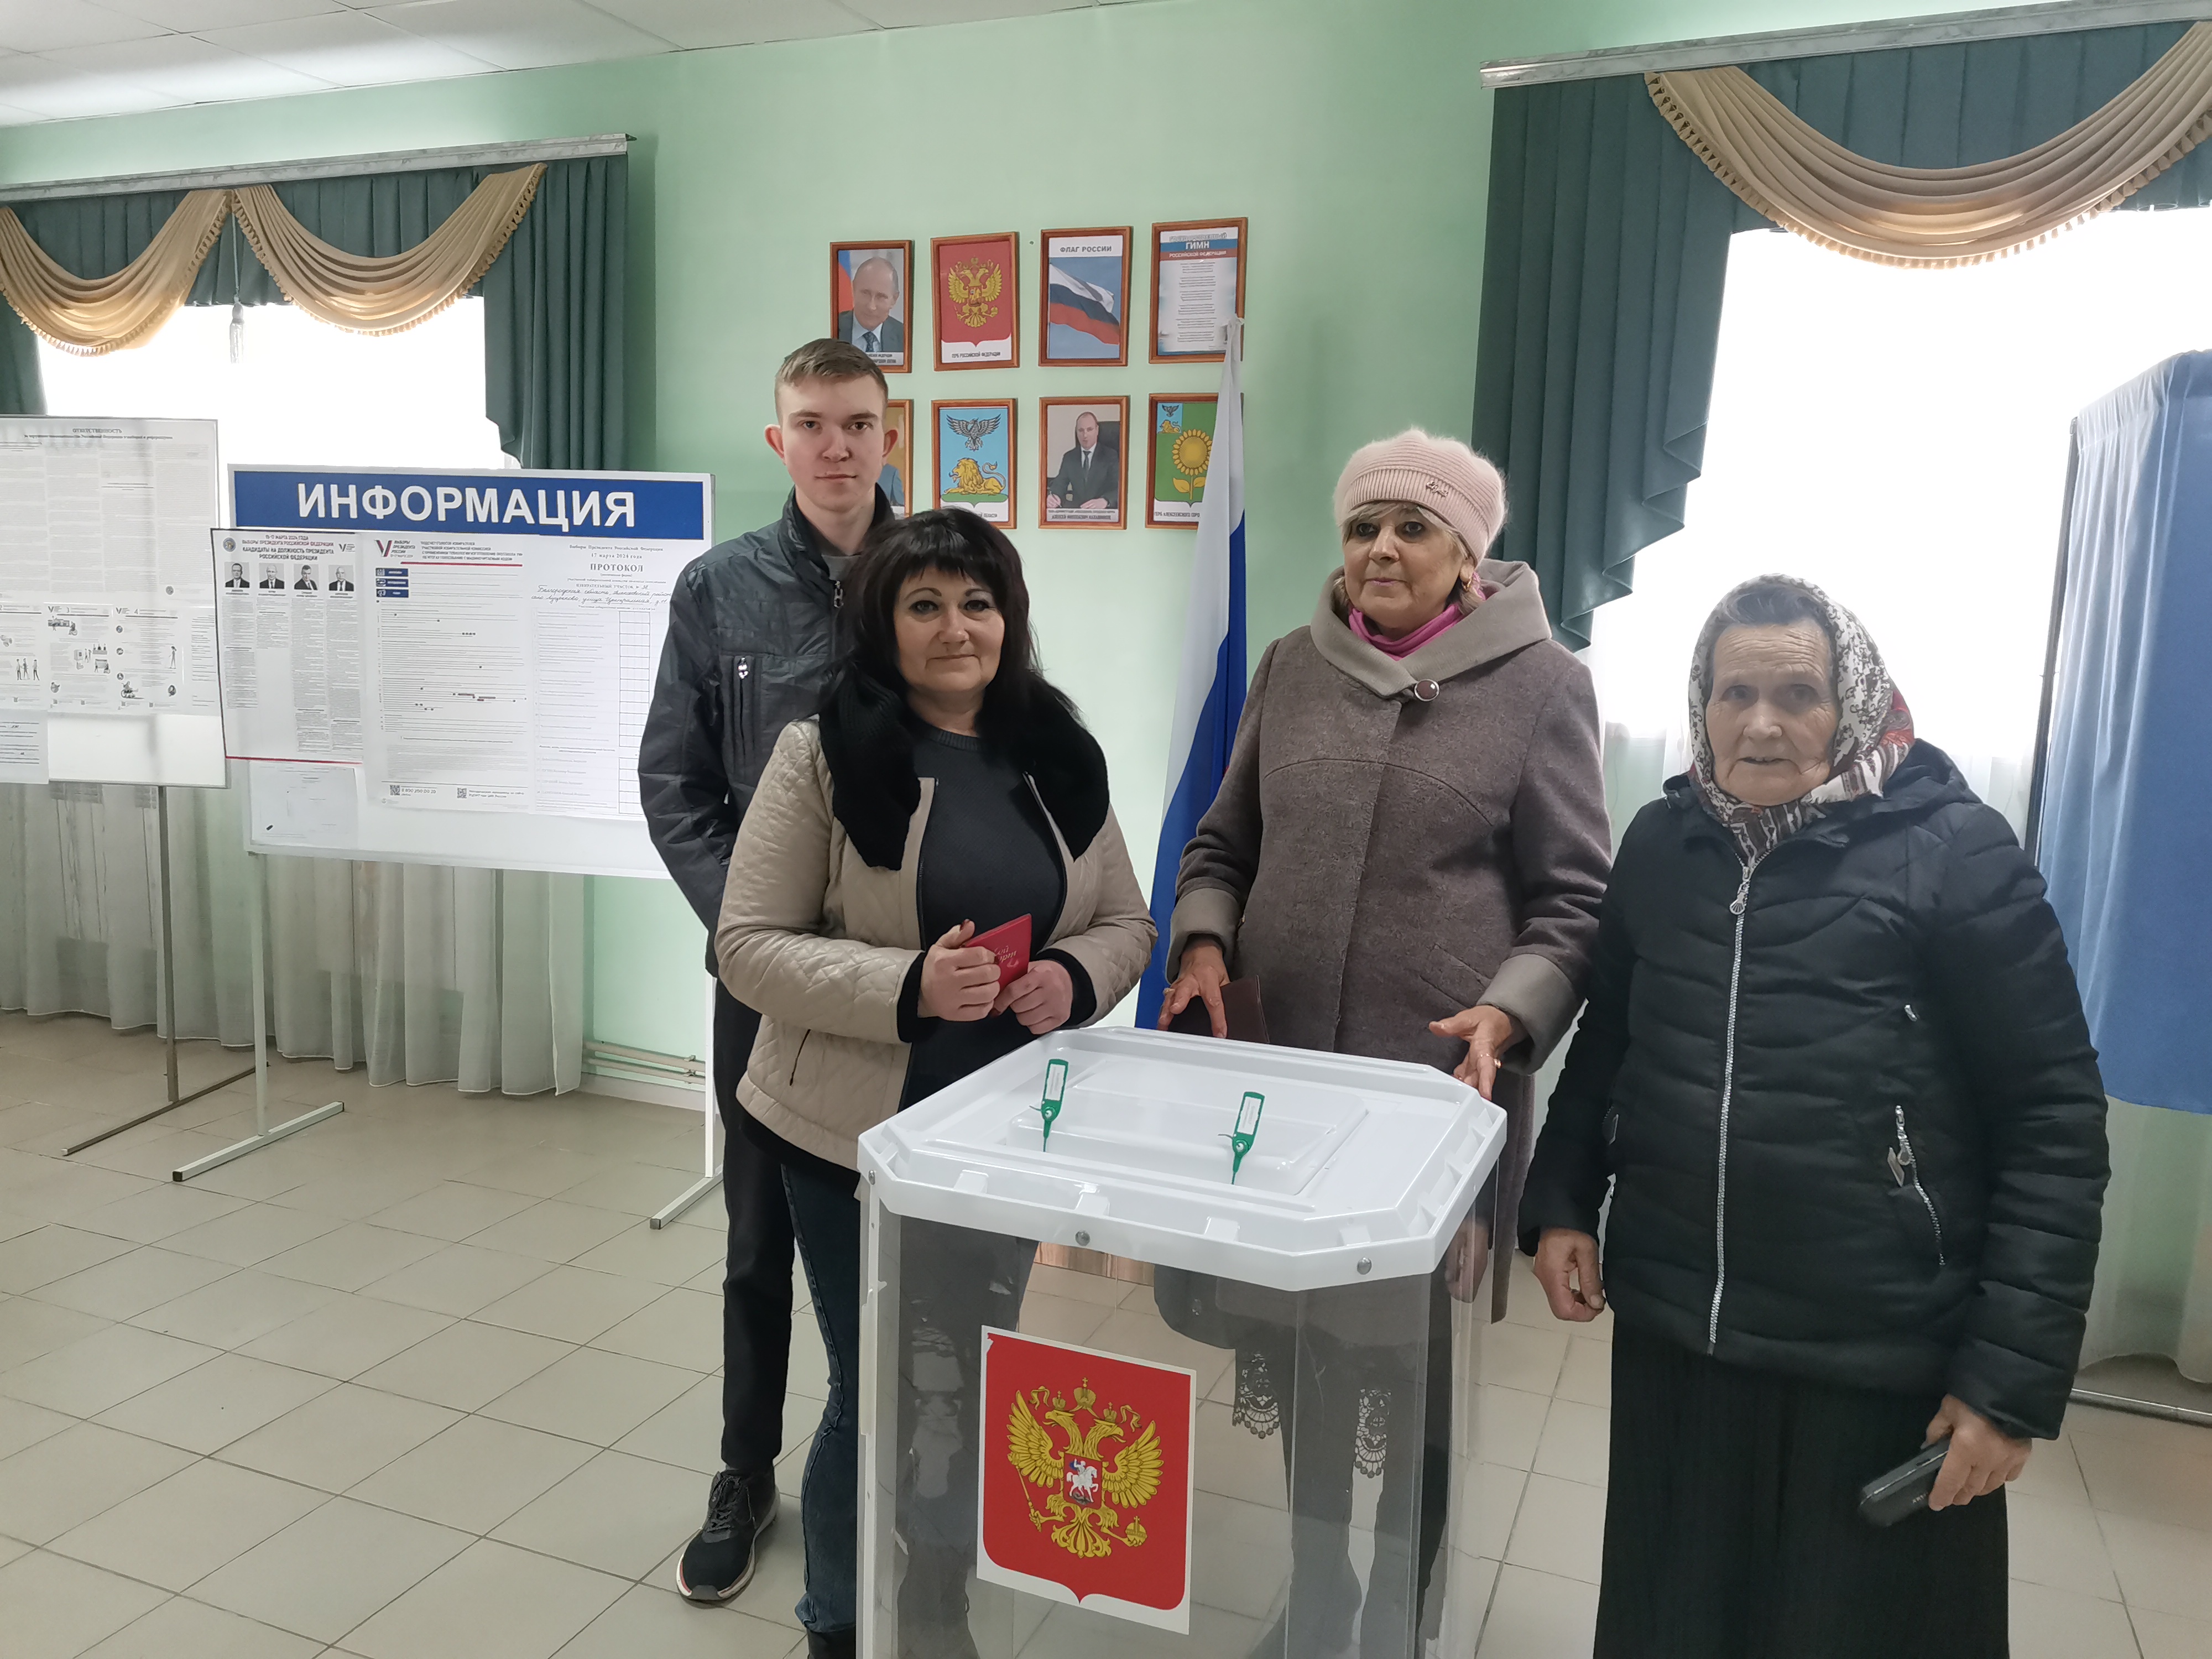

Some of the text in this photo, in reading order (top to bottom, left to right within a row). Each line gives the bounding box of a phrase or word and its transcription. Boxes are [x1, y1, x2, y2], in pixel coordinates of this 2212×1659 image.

[1186, 241, 1210, 249] ГИМН
[298, 483, 635, 532] ИНФОРМАЦИЯ
[590, 563, 644, 572] ПРОТОКОЛ
